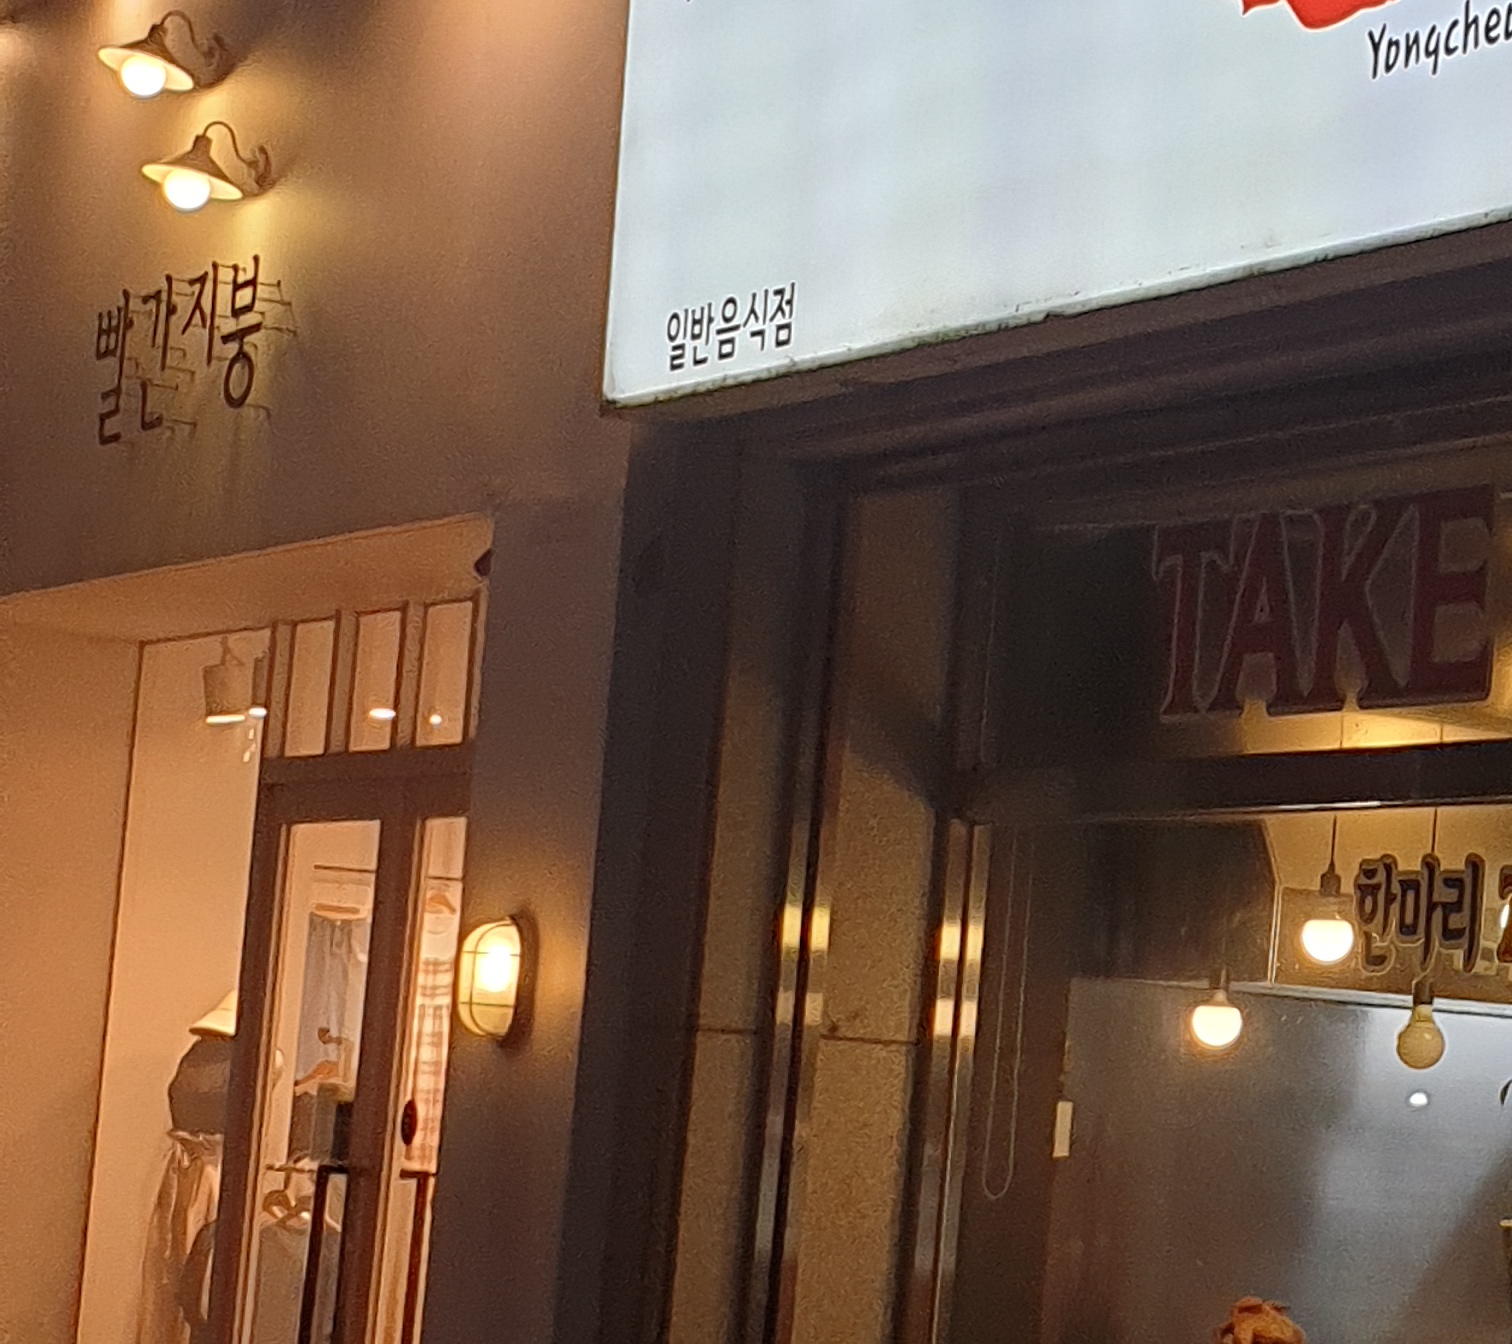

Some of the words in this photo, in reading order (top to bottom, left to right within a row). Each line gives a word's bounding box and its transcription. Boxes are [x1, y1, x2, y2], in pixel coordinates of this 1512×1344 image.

[95, 254, 263, 445] 빨간지붕
[665, 281, 797, 373] 일반음식점
[1155, 484, 1497, 720] TAKE
[1352, 853, 1485, 974] 한마리
